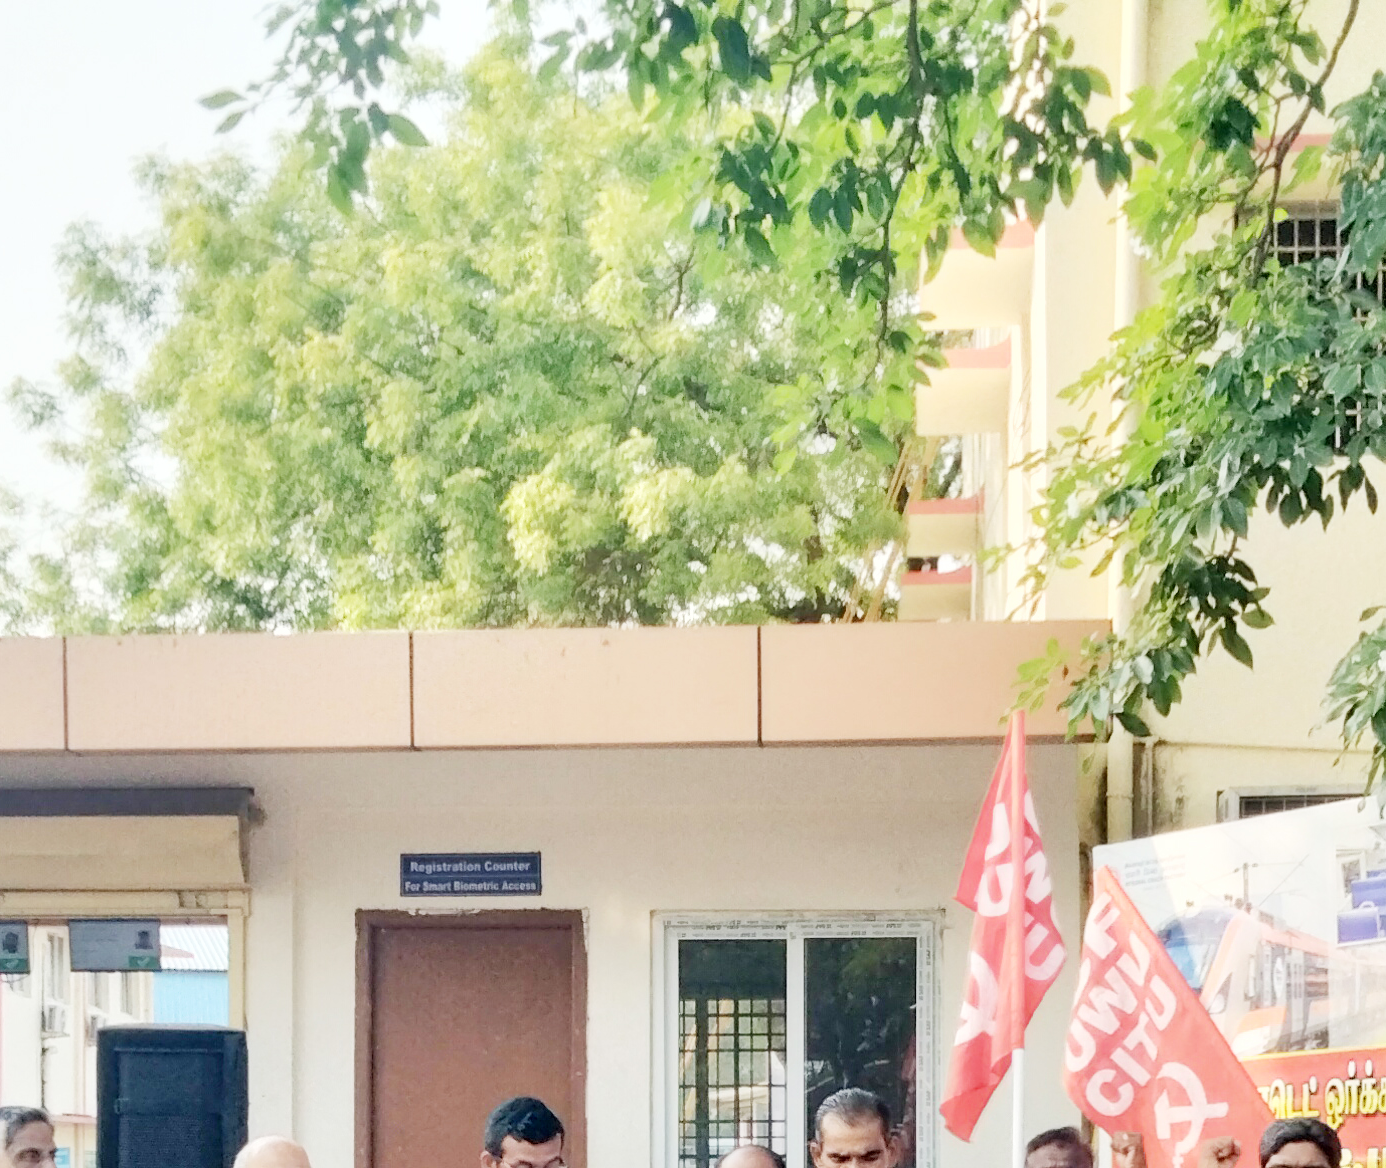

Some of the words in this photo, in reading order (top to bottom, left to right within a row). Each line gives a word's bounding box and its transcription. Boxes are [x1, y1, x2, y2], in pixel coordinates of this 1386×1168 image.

[410, 860, 481, 875] Registration
[484, 860, 531, 872] Counter
[405, 880, 421, 892] For
[423, 881, 452, 892] Smart
[453, 880, 499, 892] Biometric
[501, 880, 537, 891] Access
[1085, 974, 1179, 1117] CITU
